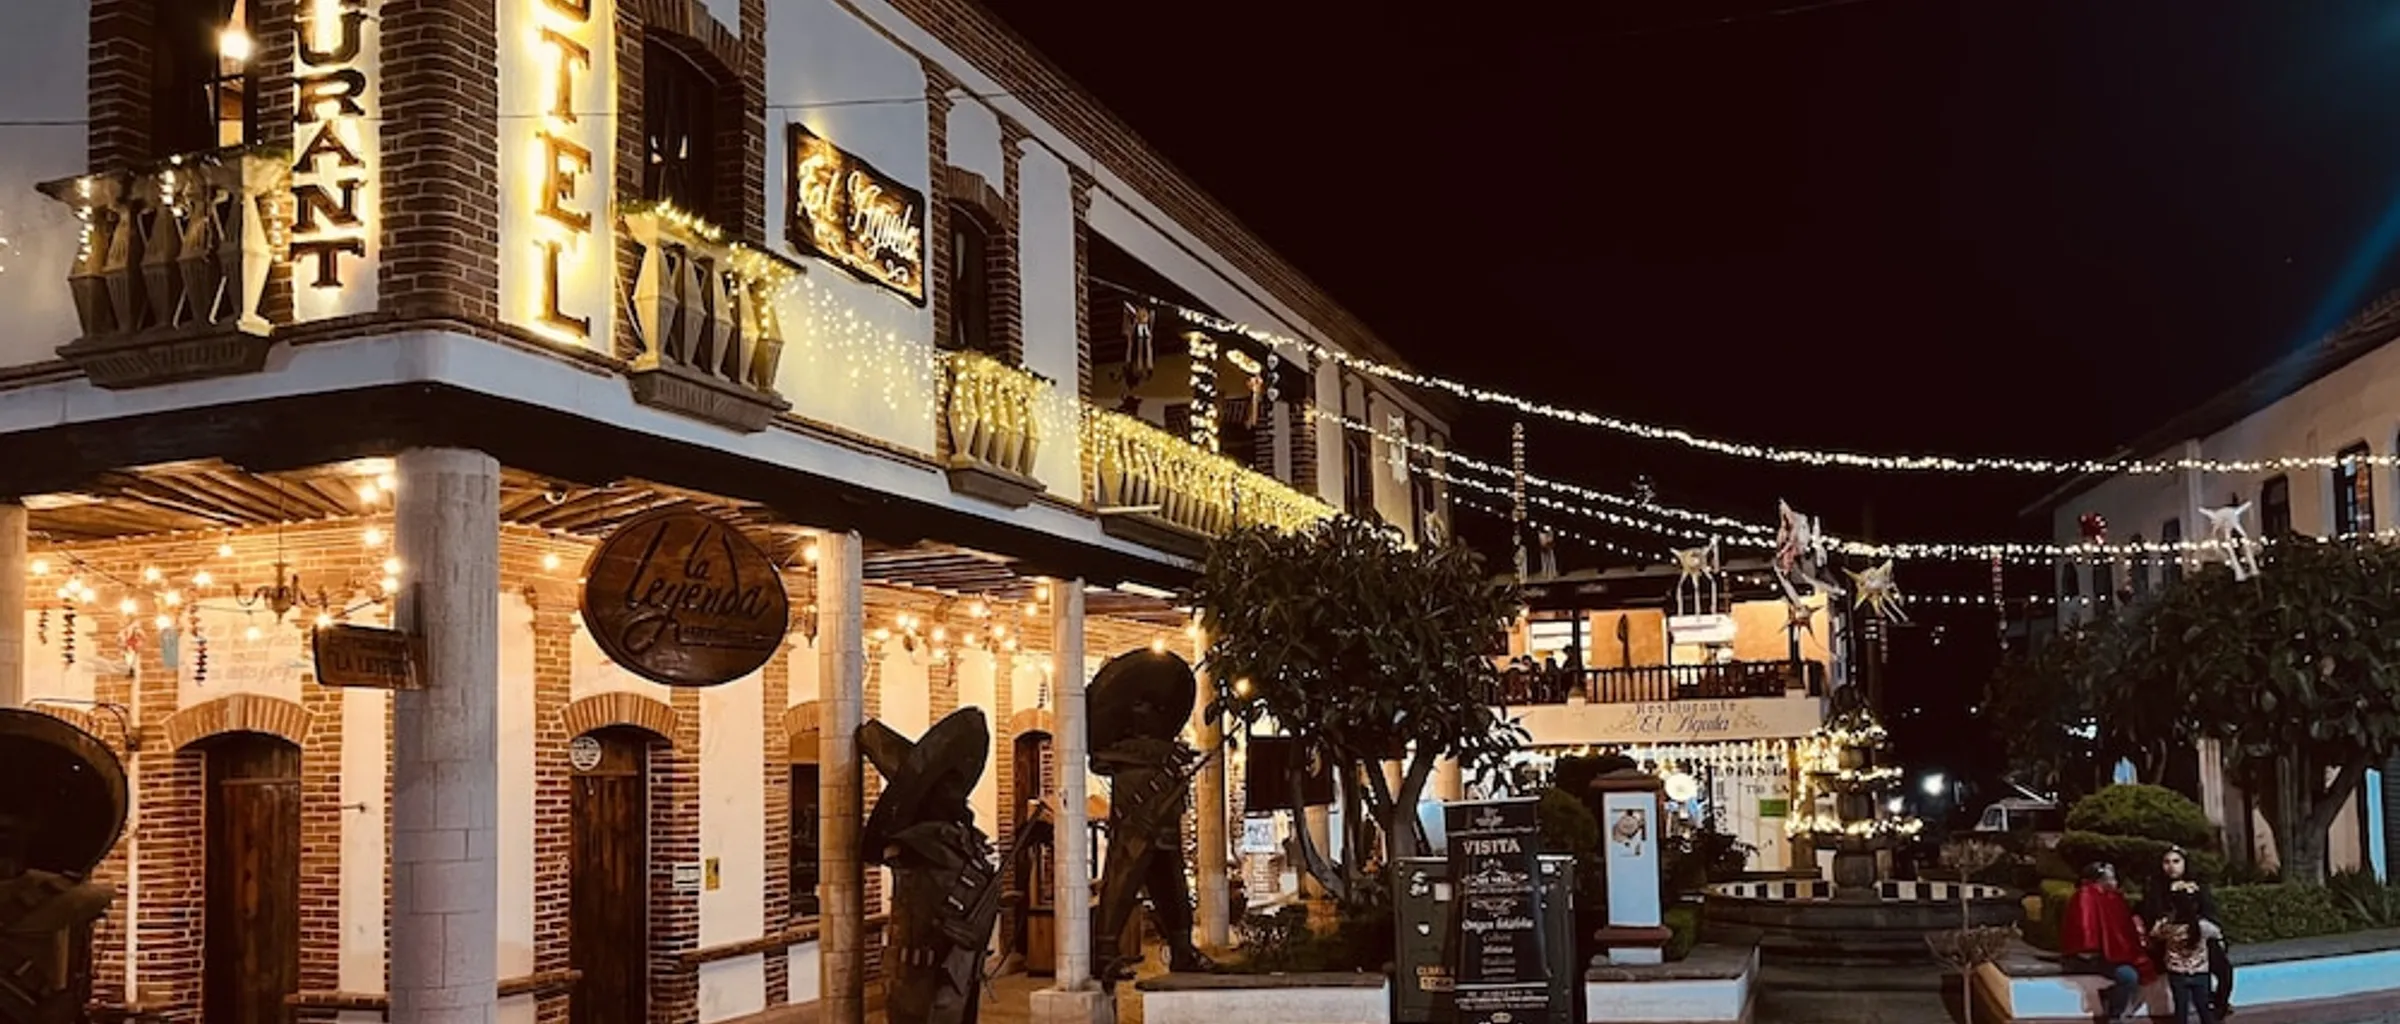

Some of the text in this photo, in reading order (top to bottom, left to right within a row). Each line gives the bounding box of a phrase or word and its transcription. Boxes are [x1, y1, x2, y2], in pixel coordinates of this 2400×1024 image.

[291, 0, 368, 288] URANT
[533, 0, 591, 339] TEL
[797, 154, 841, 220] El
[1636, 702, 1737, 714] Restaurante
[1462, 838, 1521, 855] VISITA
